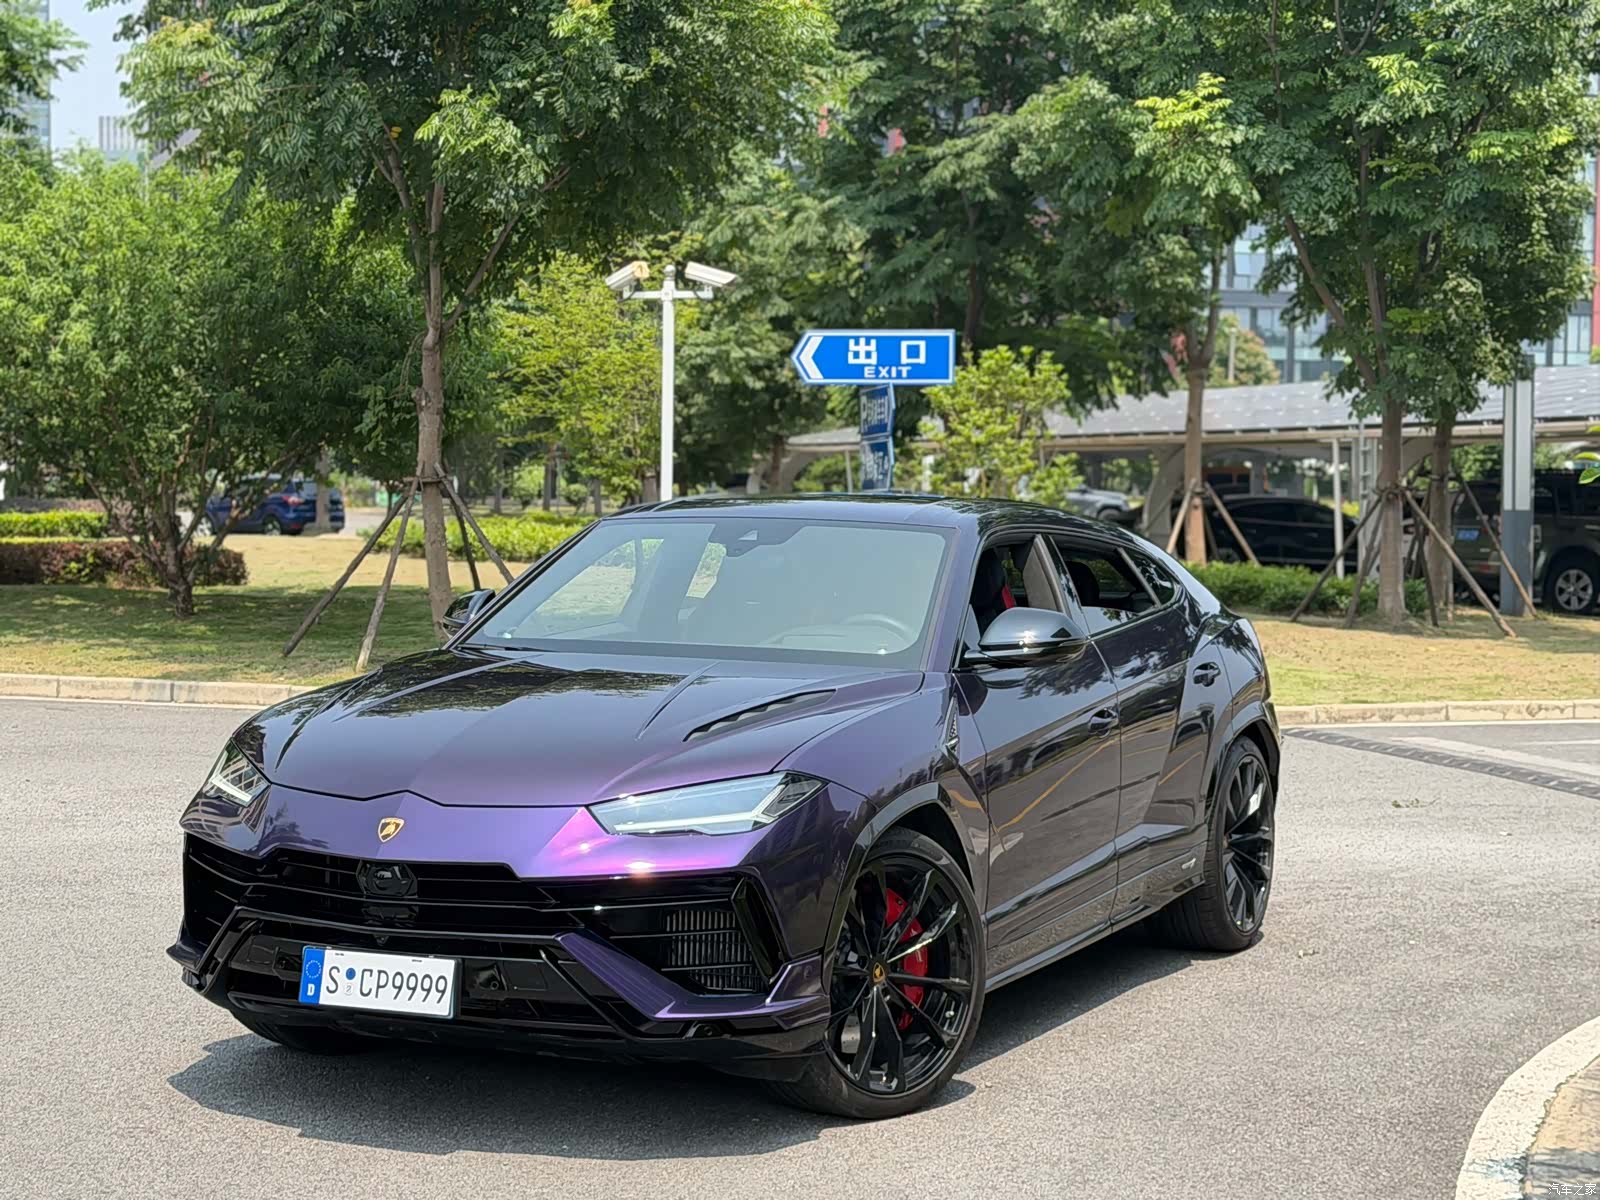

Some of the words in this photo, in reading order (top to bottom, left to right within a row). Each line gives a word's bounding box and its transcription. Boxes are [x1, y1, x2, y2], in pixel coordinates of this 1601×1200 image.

[848, 337, 926, 365] 出口
[864, 366, 912, 378] EXIT
[306, 983, 316, 996] D
[326, 966, 340, 994] S
[359, 968, 448, 1004] CP9999
